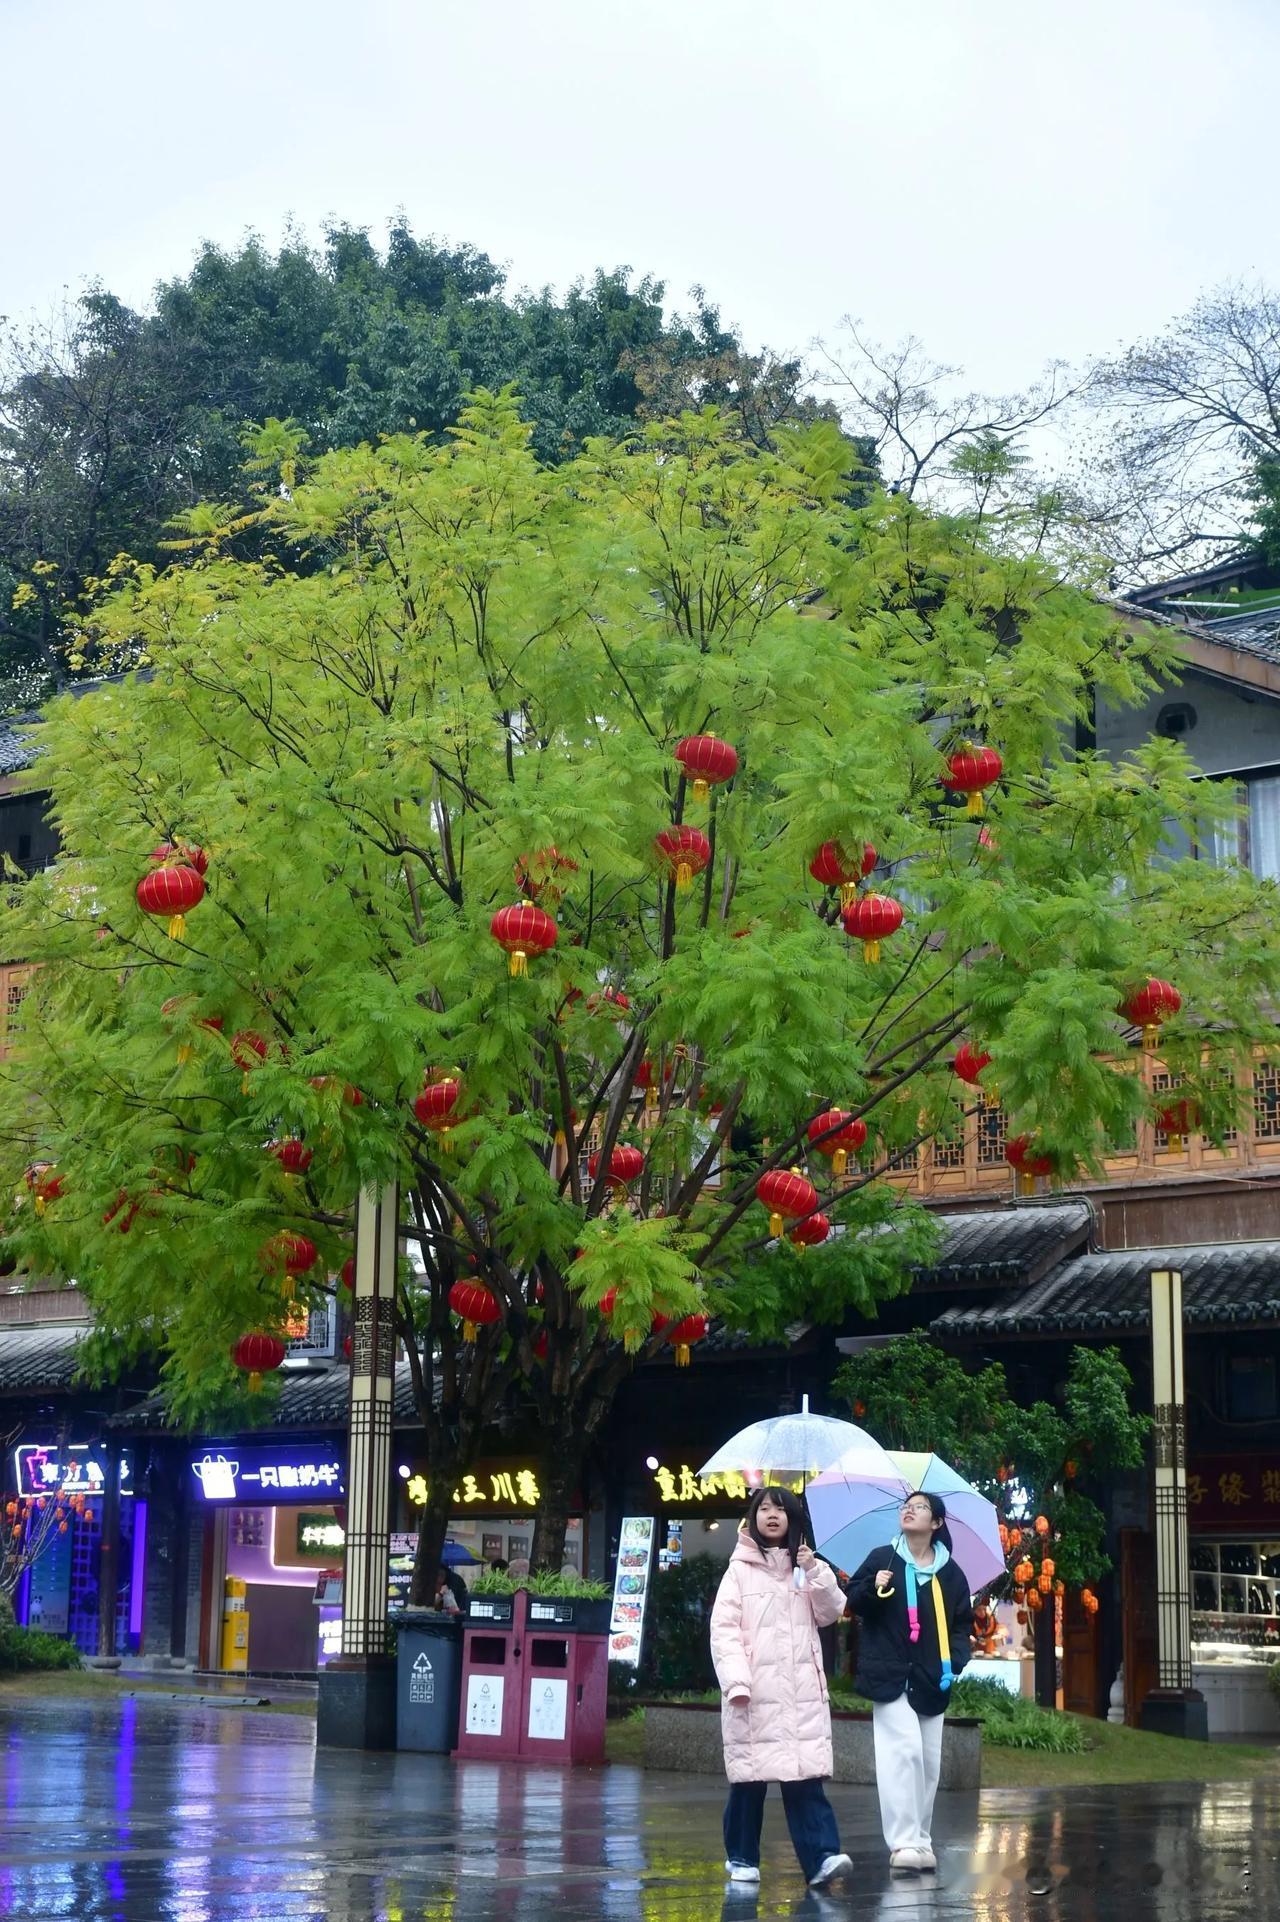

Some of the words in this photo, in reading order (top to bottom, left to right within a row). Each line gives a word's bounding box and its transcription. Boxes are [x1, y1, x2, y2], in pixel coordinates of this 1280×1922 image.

[241, 1463, 338, 1488] 一只酸奶牛
